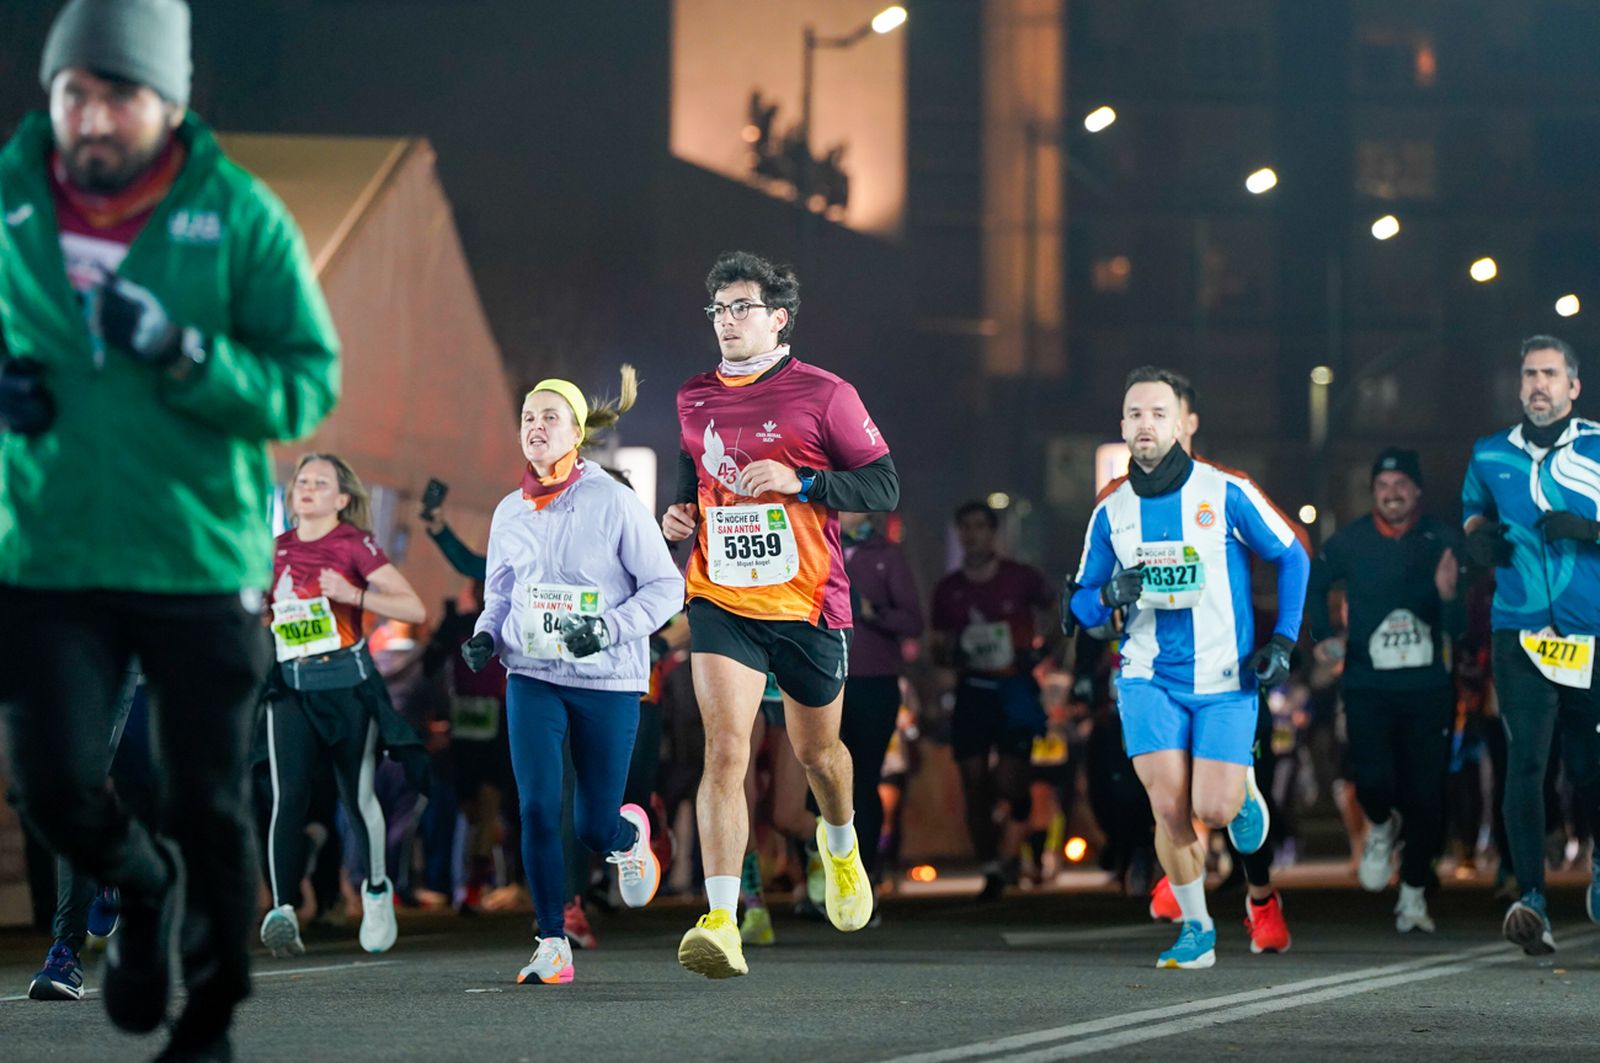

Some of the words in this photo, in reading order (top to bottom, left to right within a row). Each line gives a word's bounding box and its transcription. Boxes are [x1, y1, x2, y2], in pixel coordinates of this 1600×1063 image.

[717, 462, 738, 484] 43
[725, 515, 748, 523] NOCHE
[749, 514, 759, 522] DE
[717, 525, 733, 534] SAN
[734, 523, 761, 533] ANTÓN
[724, 533, 782, 559] 5359
[1142, 564, 1197, 586] 13327
[540, 592, 561, 600] NOCHE
[563, 593, 573, 601] DE
[532, 601, 545, 609] SAN
[1536, 640, 1577, 661] 4277
